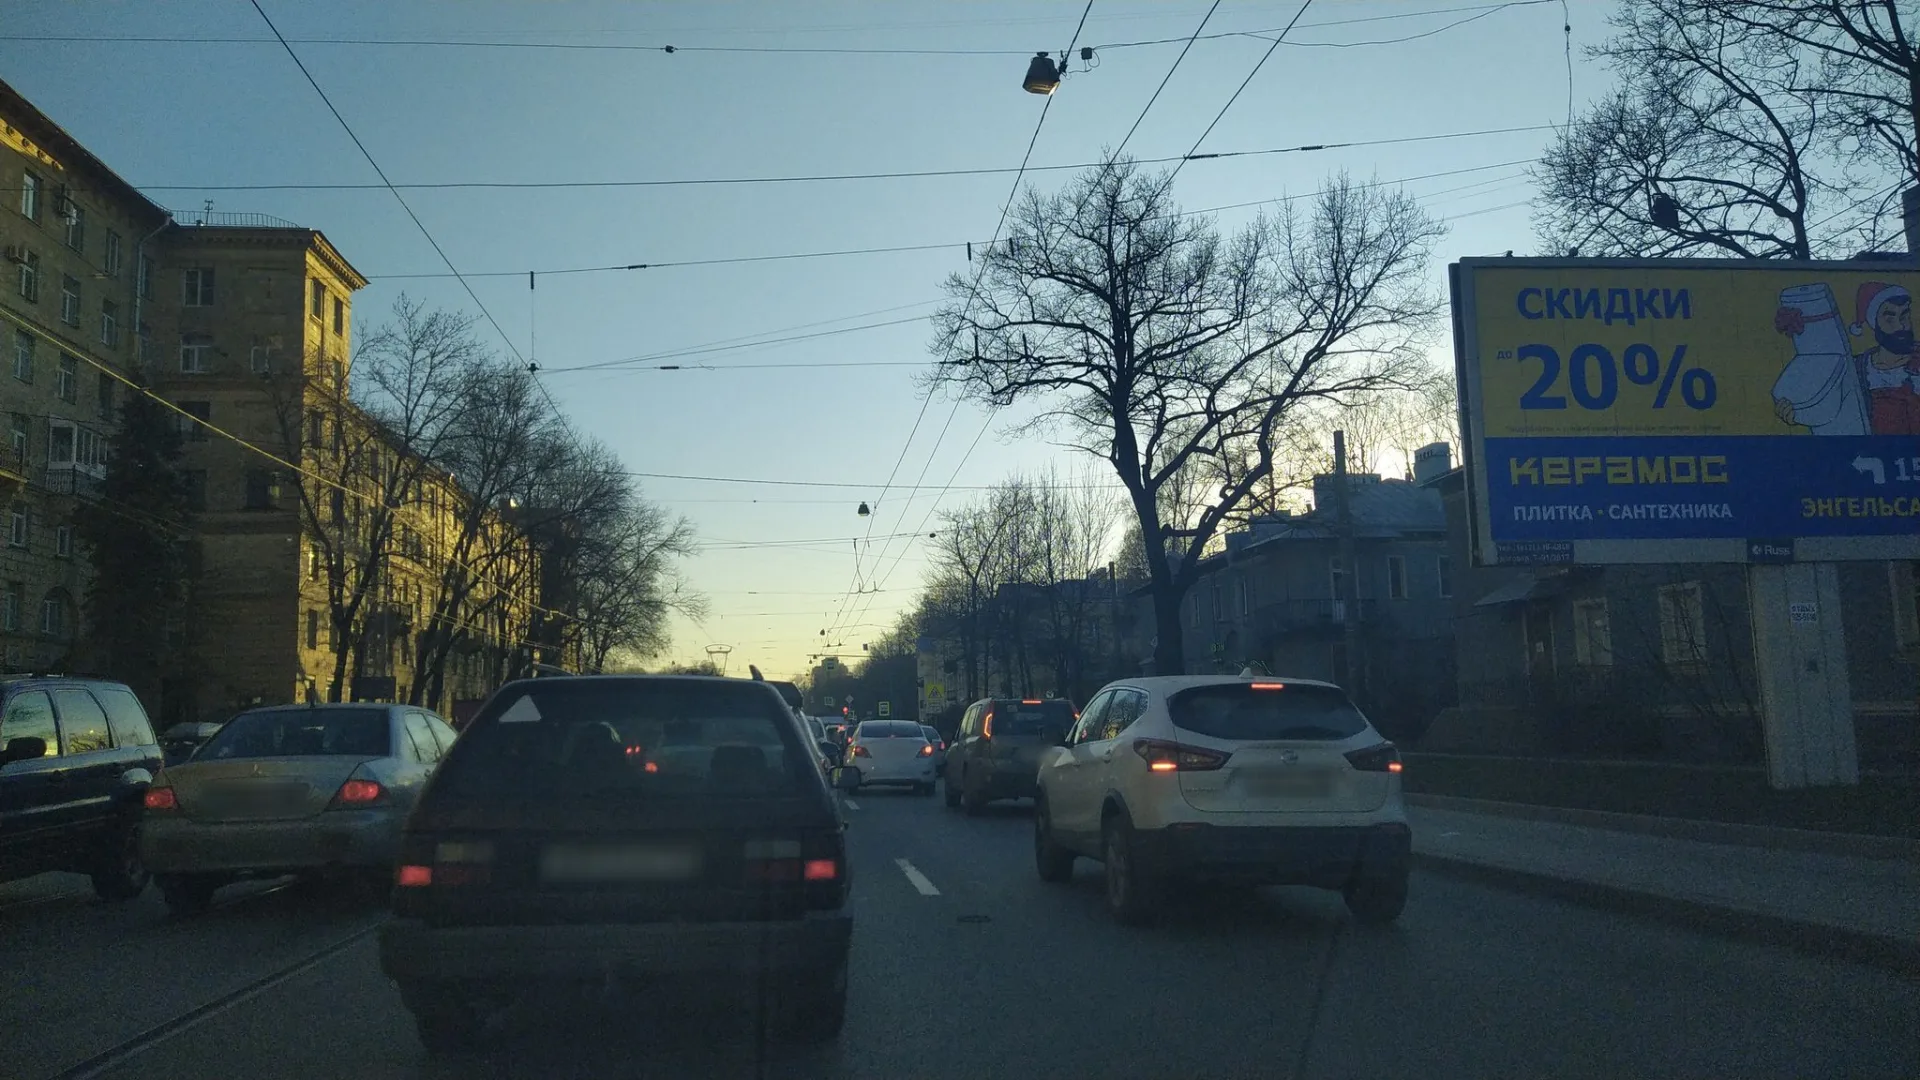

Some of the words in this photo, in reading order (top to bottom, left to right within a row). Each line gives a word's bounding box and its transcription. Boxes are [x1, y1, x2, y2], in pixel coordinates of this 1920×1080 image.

[1518, 287, 1692, 326] СКИДКИ
[1517, 343, 1718, 410] 20%
[1513, 505, 1594, 521] ПЛИТКА
[1608, 503, 1733, 521] САНТЕХНИКА
